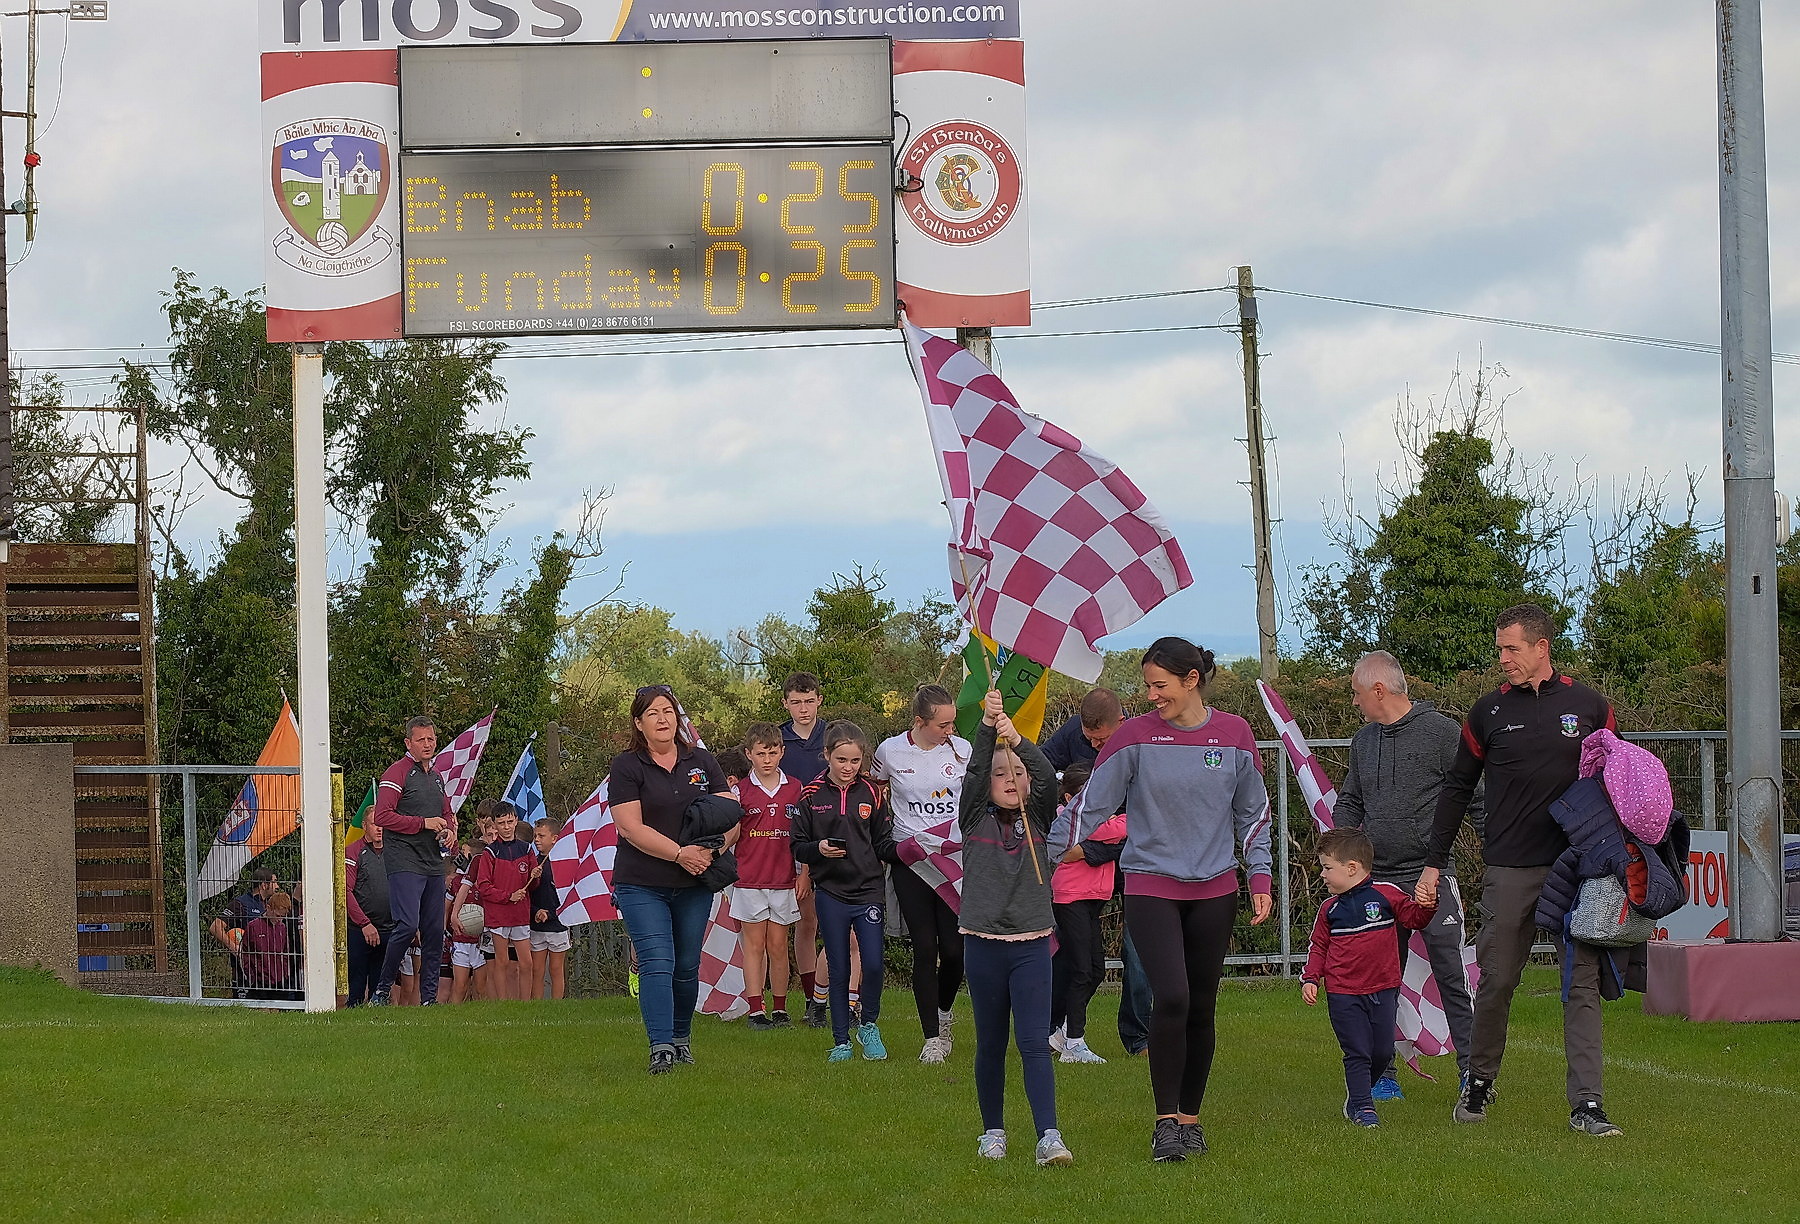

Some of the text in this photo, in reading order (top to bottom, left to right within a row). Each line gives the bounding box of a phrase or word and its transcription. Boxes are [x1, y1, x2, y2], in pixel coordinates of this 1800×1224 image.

[282, 0, 583, 43] moss
[649, 2, 1006, 29] www.mossconstruction.com
[283, 121, 379, 140] Baile Mhic An Aba
[931, 129, 1007, 164] Brenda's
[406, 173, 592, 233] Bnab
[912, 203, 1010, 239] Ballymacnab
[298, 255, 312, 268] Na
[407, 253, 681, 313] Funday
[449, 316, 655, 332] FSL SCOREBOARDS +44 (0) 28 8676 6131
[769, 807, 776, 816] 9
[908, 801, 955, 814] moss
